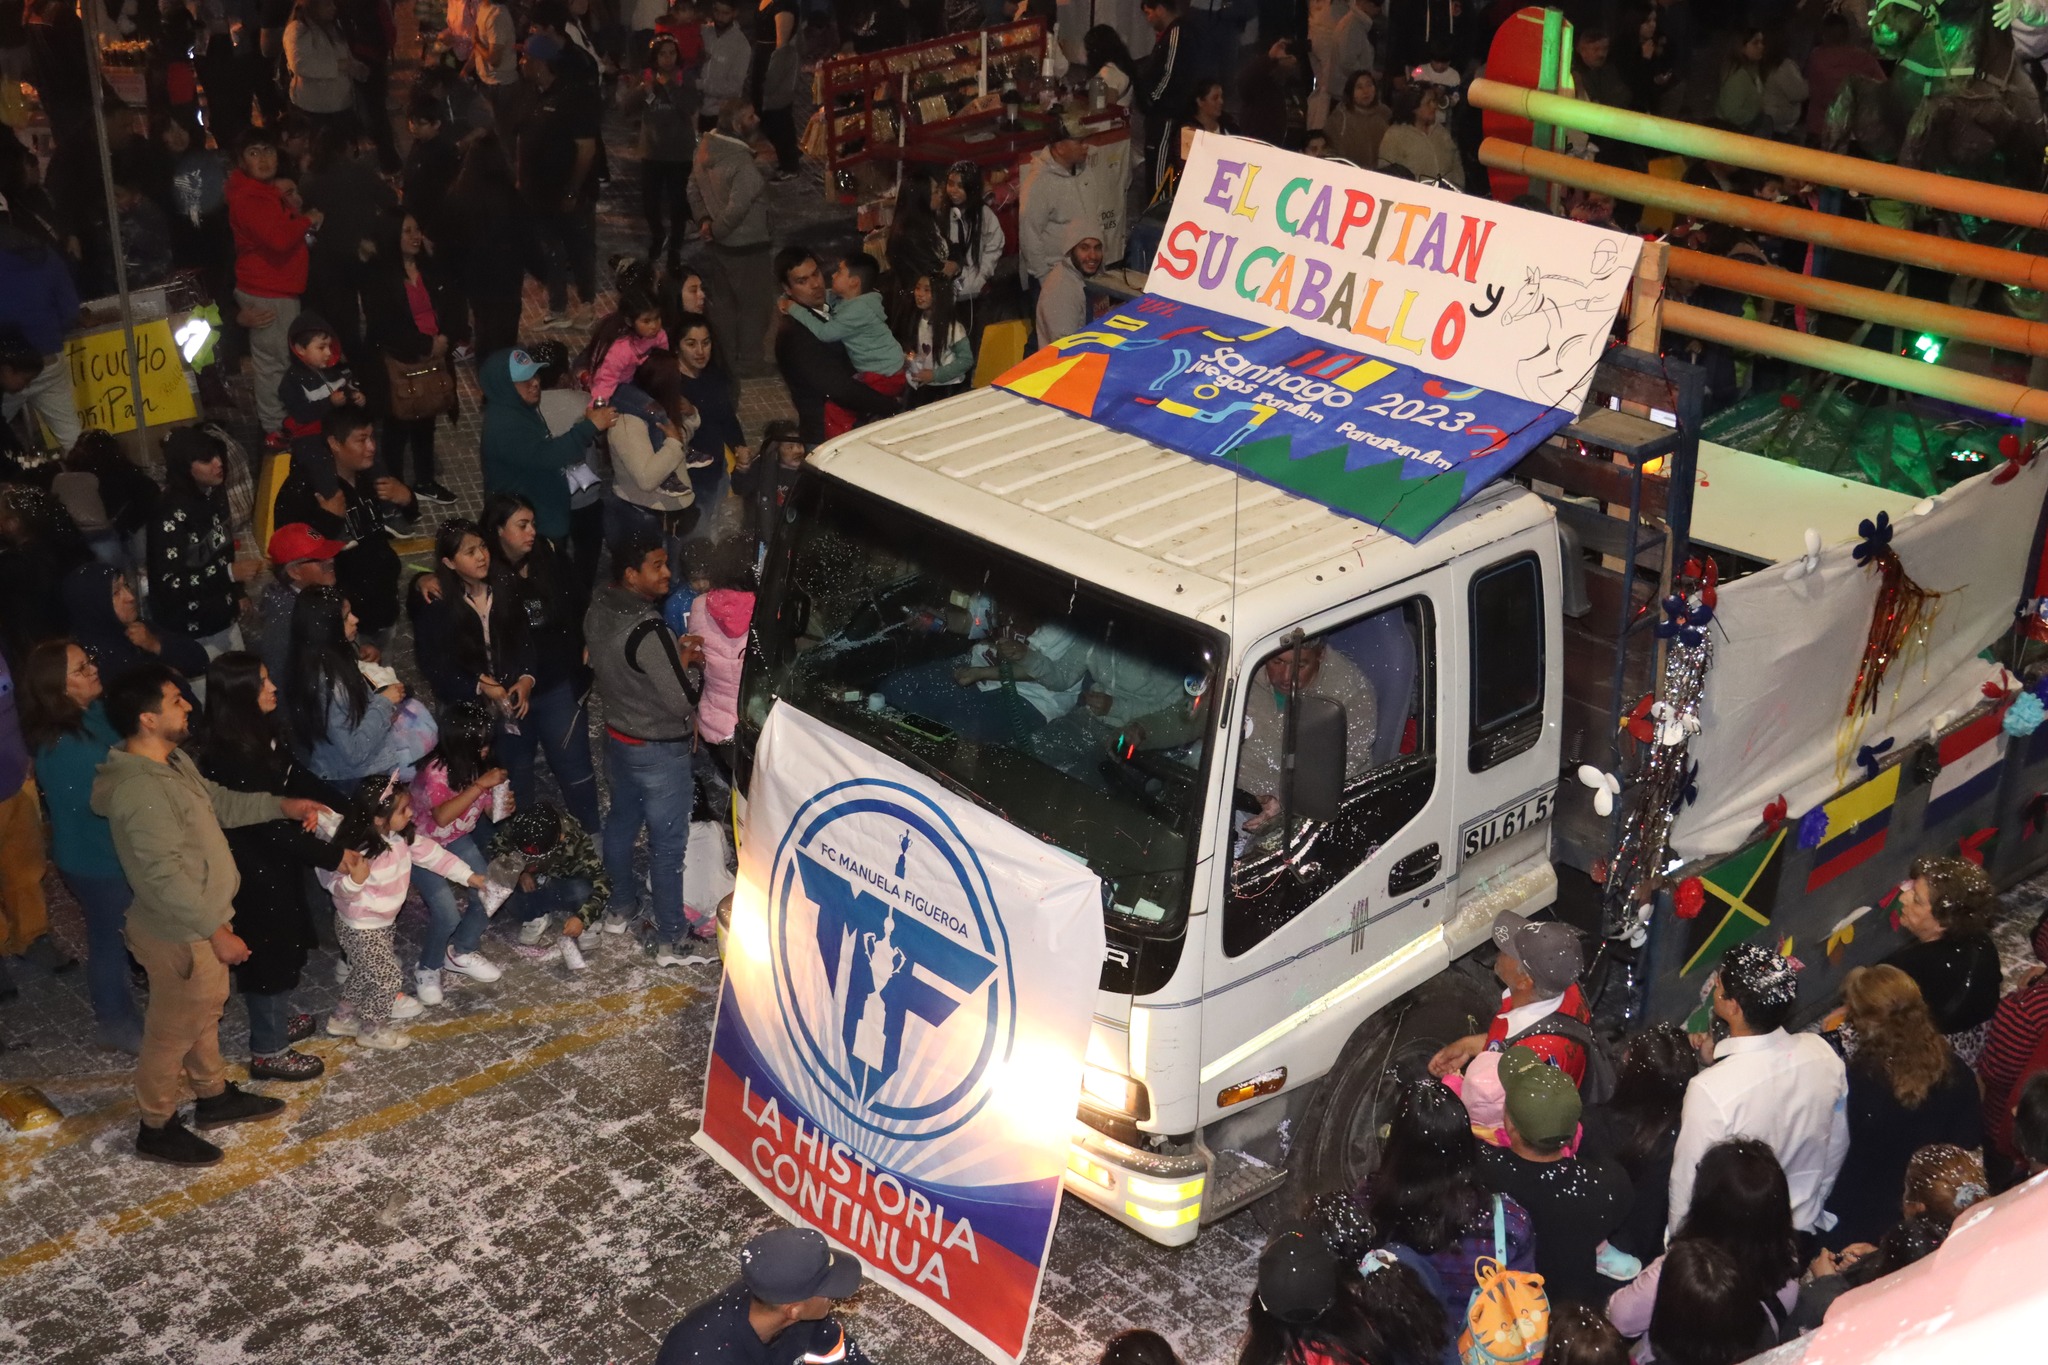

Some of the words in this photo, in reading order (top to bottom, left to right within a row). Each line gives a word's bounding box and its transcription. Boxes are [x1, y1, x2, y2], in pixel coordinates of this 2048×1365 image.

[1203, 159, 1262, 222] EL
[1275, 177, 1498, 284] CAPITAN
[1153, 221, 1239, 290] SU
[1235, 246, 1466, 360] CABALLO
[1469, 283, 1505, 318] y
[1200, 347, 1353, 408] Santiago
[1363, 393, 1476, 432] 2023
[1252, 392, 1325, 424] PanAm
[1336, 422, 1453, 470] ParaPanAm
[820, 843, 837, 862] FC
[839, 857, 901, 900] MANUELA
[904, 890, 969, 939] FIGUEROA
[742, 1076, 783, 1142] LA
[794, 1116, 980, 1265] HISTORIA
[752, 1136, 950, 1300] CONTINUA
